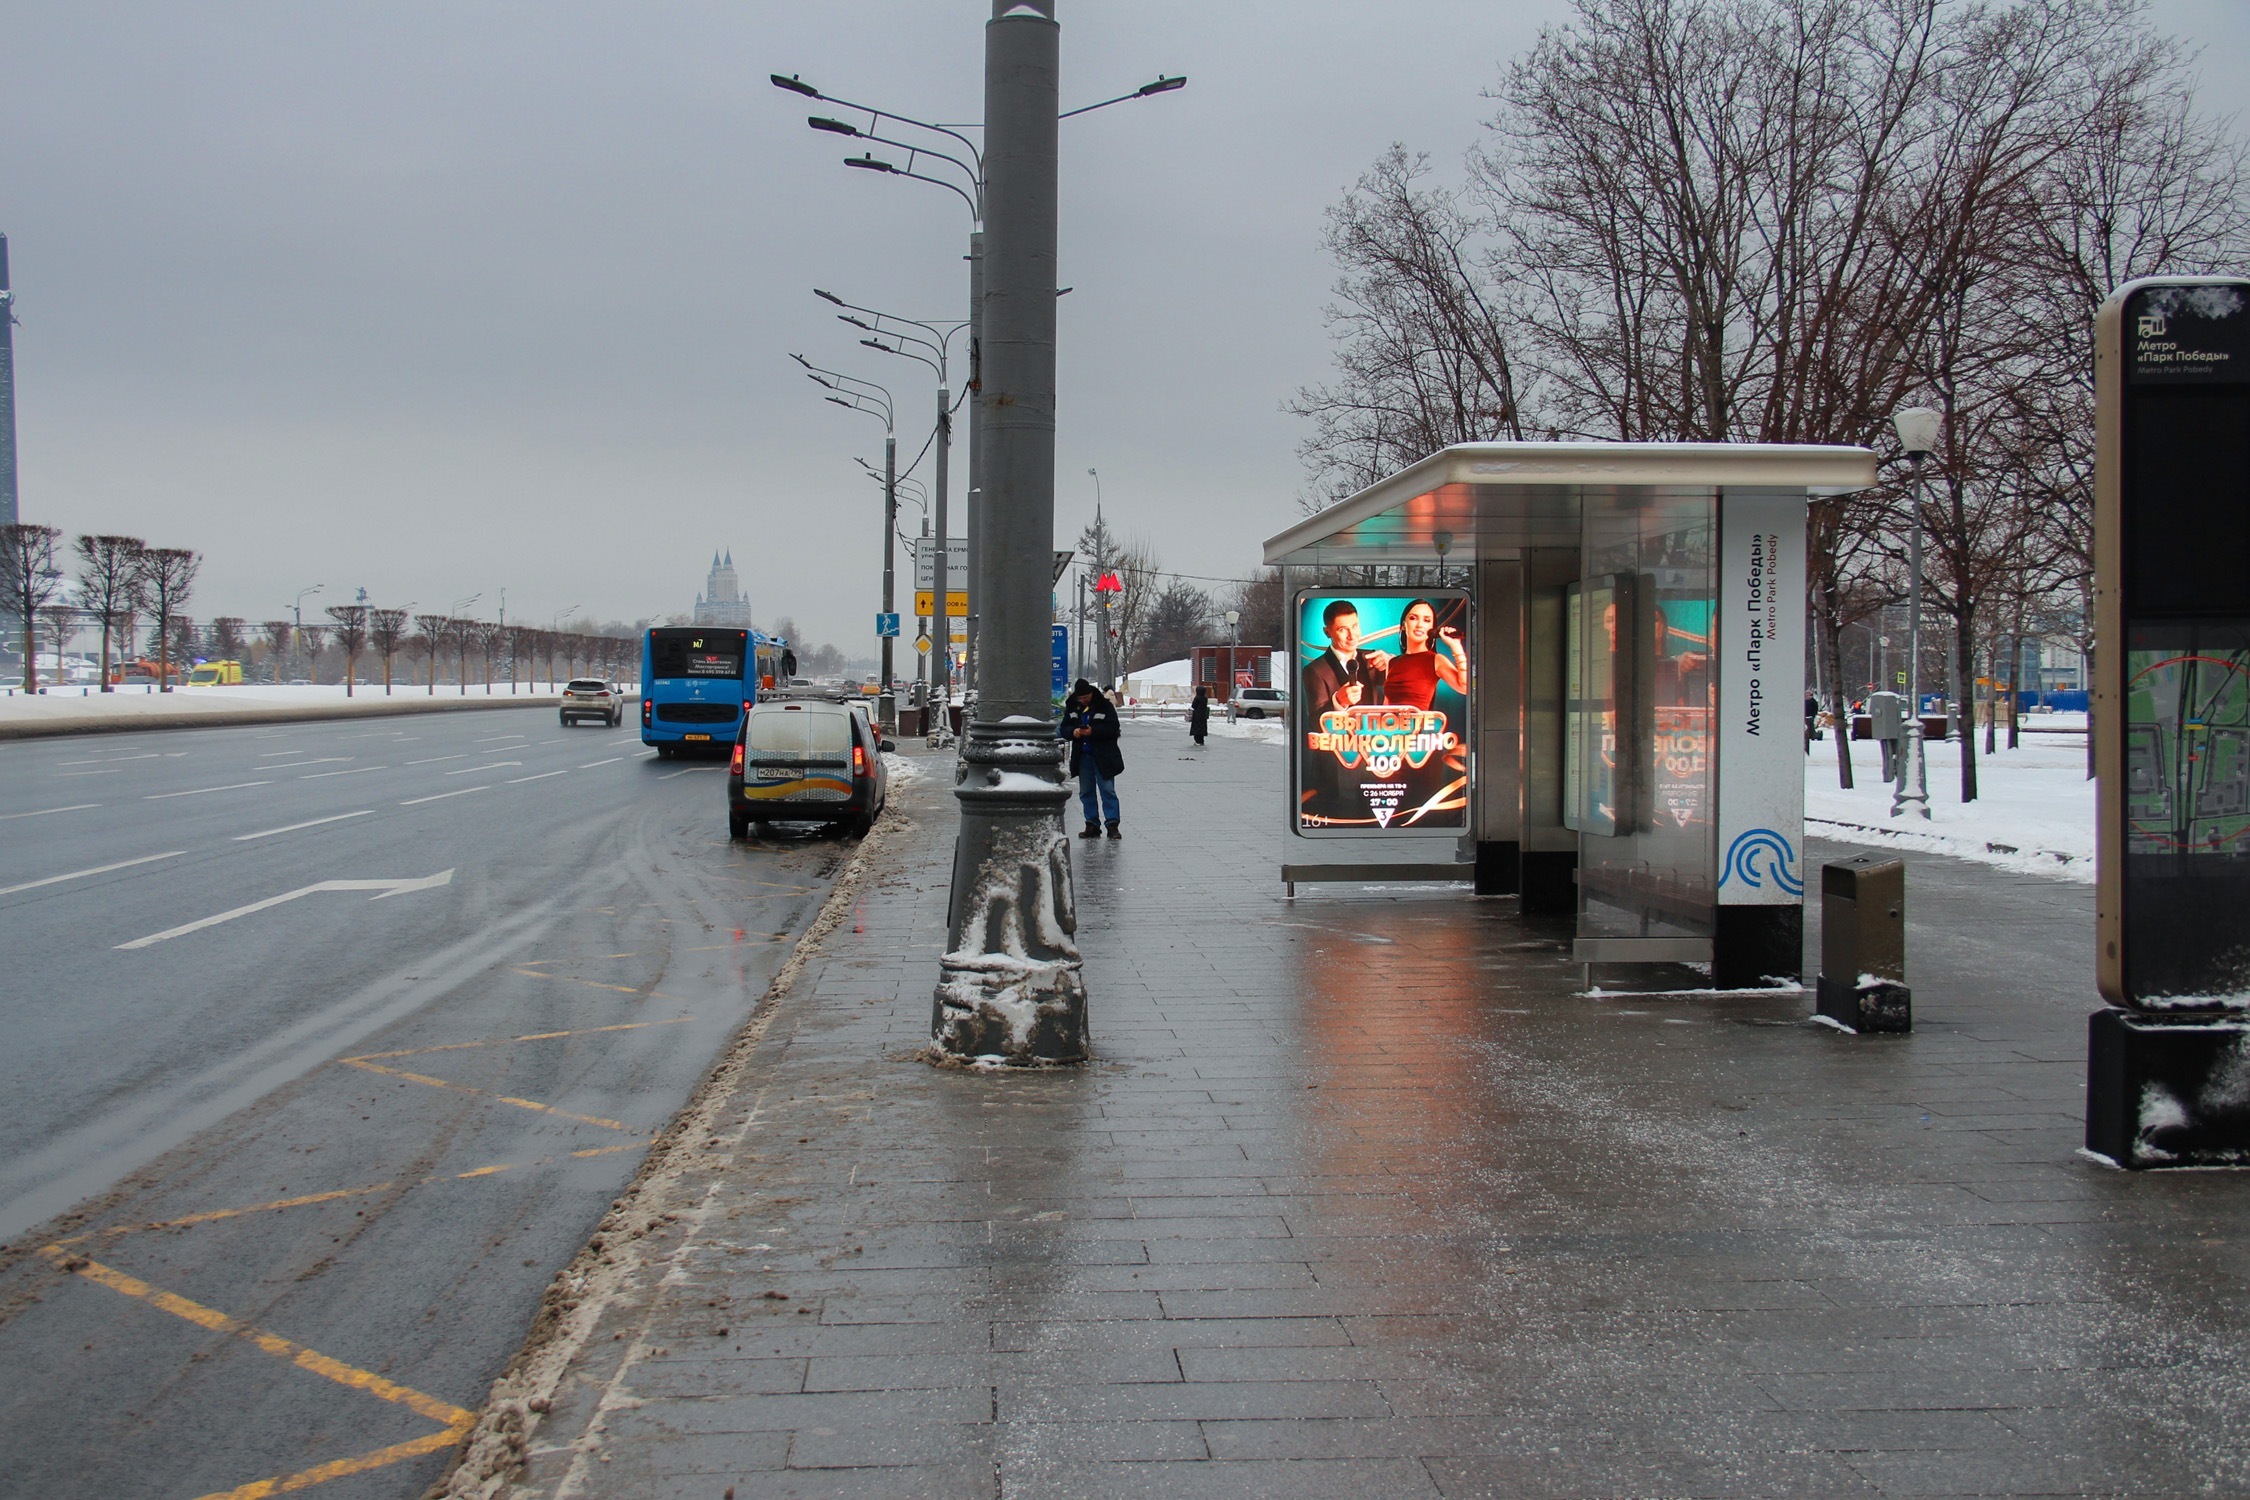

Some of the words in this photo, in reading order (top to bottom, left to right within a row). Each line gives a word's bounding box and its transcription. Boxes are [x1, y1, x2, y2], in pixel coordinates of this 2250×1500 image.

[2137, 341, 2177, 351] Метро
[2138, 352, 2173, 363] «Парк
[2176, 350, 2230, 362] Победы»
[2183, 365, 2214, 374] Pobedy
[1767, 534, 1779, 575] Pobedy
[1747, 534, 1764, 612] Победы»
[1767, 579, 1776, 603] Park
[1766, 607, 1776, 640] Metro
[1747, 618, 1764, 672] «Парк
[1746, 678, 1763, 736] Метро
[1332, 712, 1361, 731] ВЫ
[1308, 732, 1458, 752] ВЕЛИКОЛЕПНО
[1366, 755, 1402, 772] 100
[1302, 814, 1330, 827] 16+
